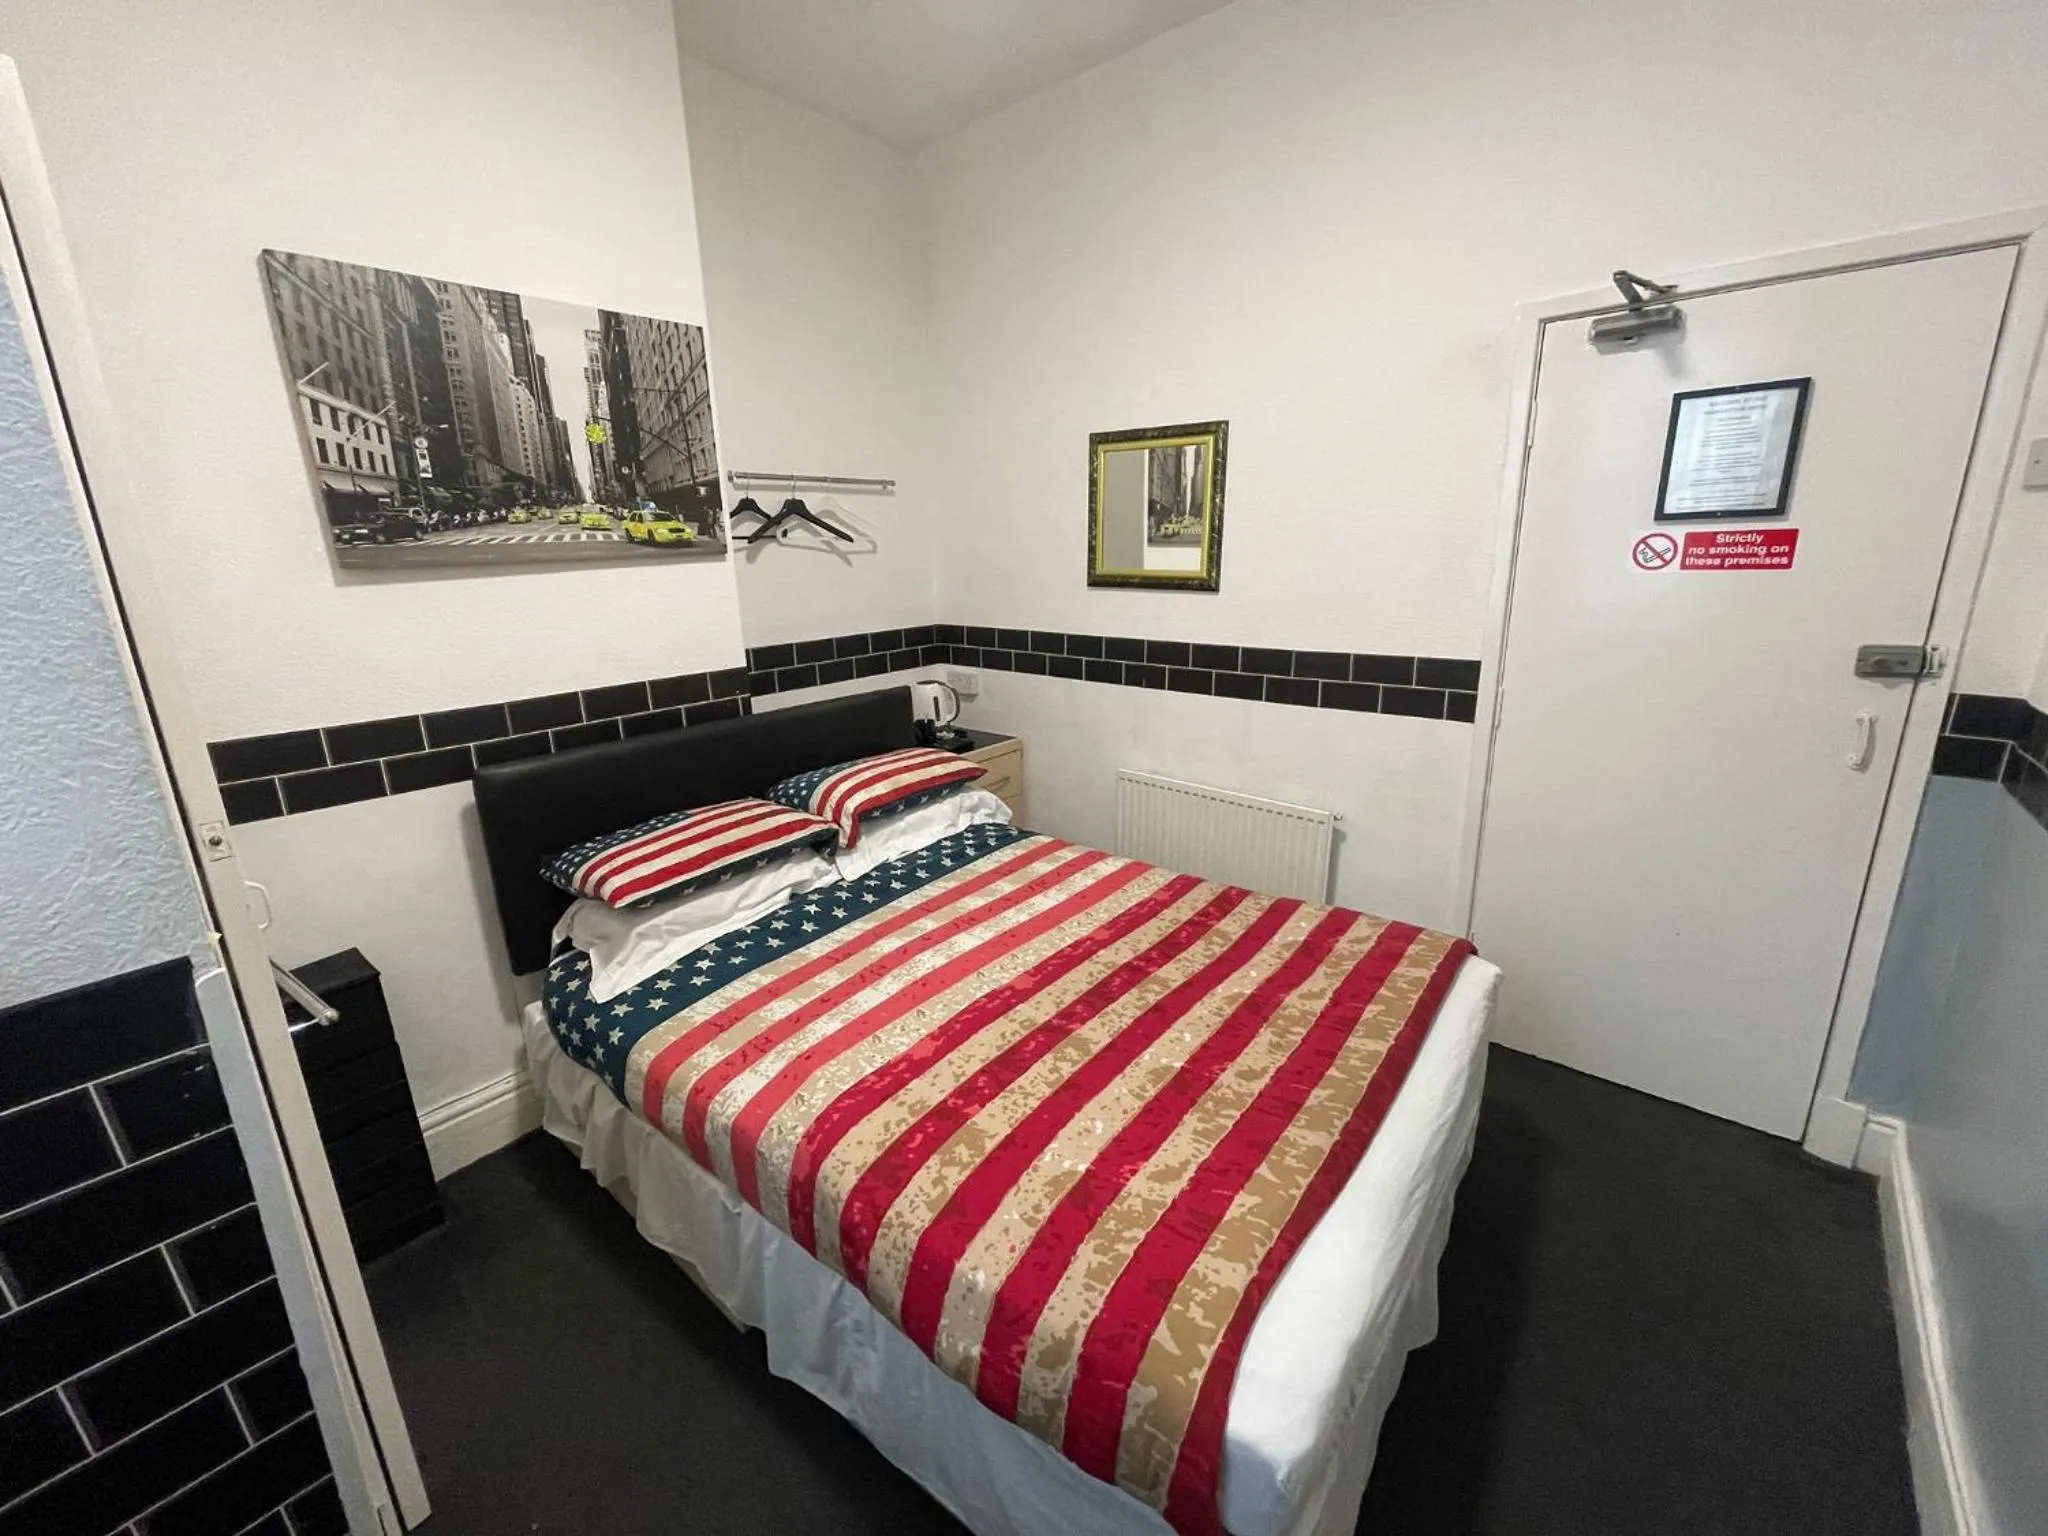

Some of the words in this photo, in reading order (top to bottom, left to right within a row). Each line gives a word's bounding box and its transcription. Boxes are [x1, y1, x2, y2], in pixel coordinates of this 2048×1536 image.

[1716, 533, 1764, 544] Strictly
[1688, 546, 1705, 554] no
[1709, 544, 1767, 556] smoking
[1771, 545, 1789, 553] on
[1685, 556, 1721, 565] these
[1724, 557, 1788, 567] premises
